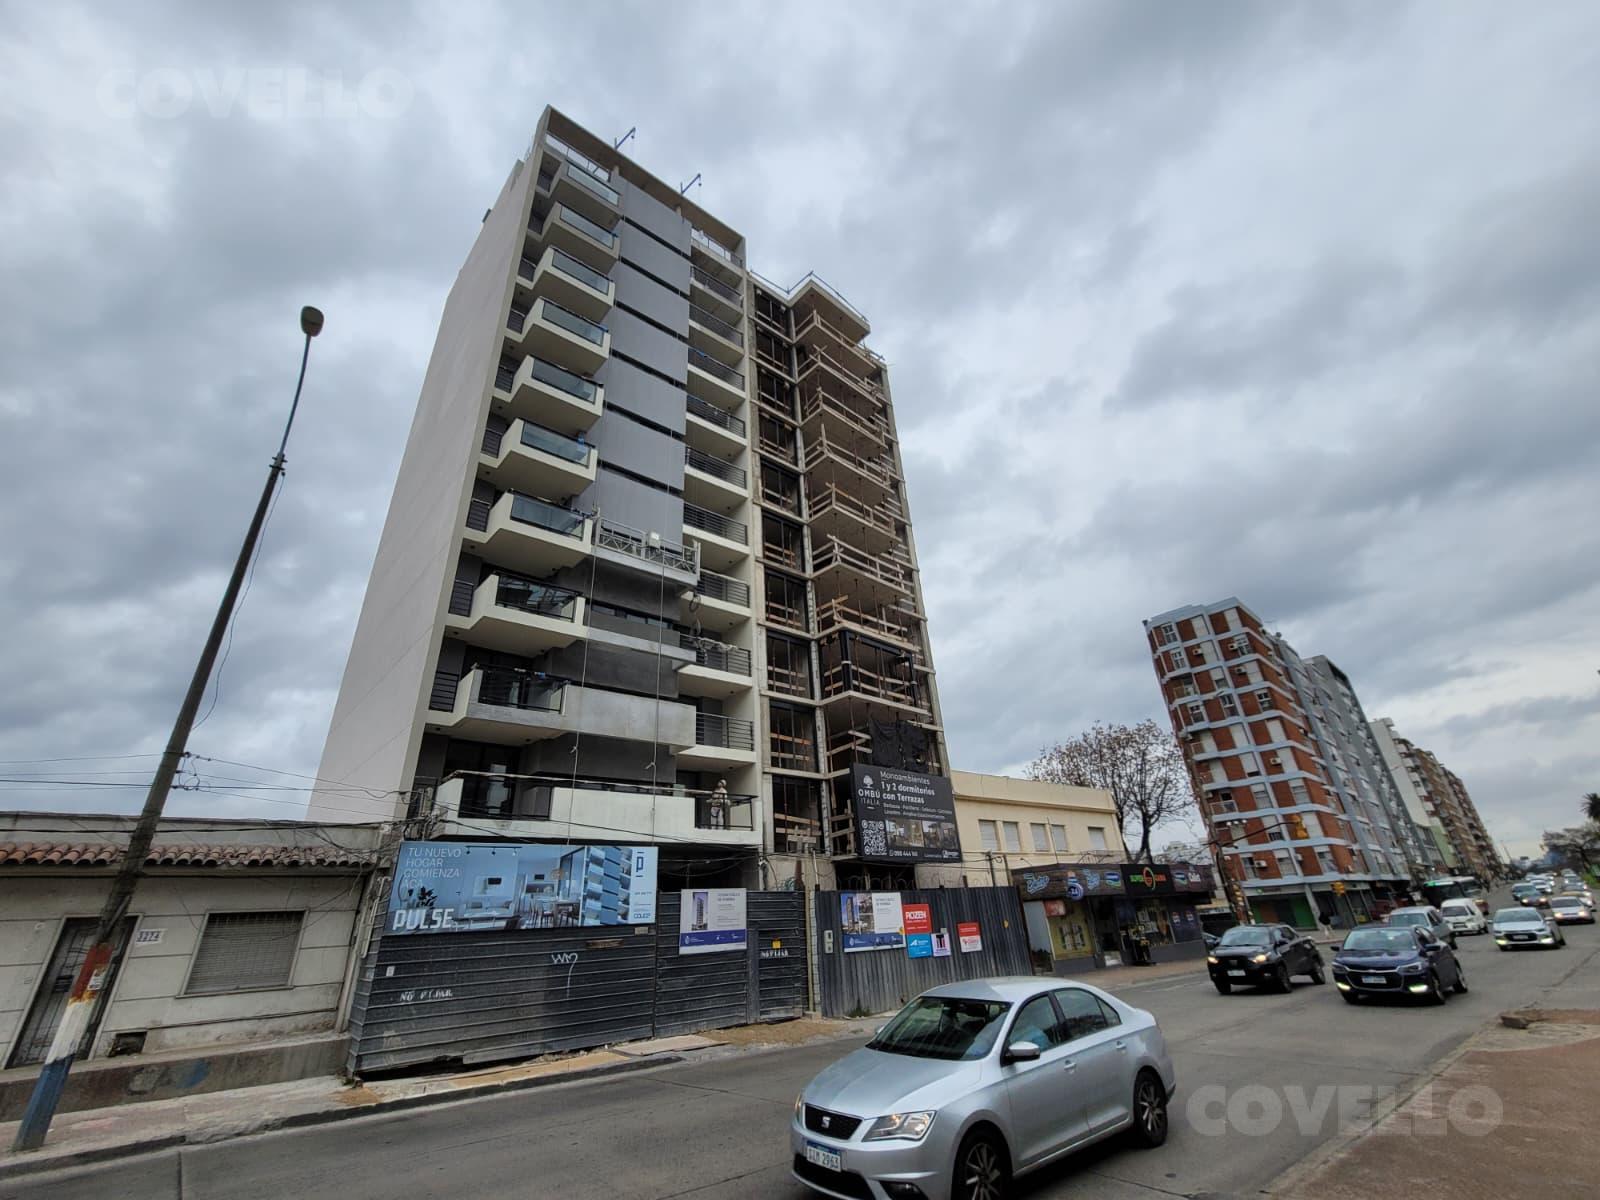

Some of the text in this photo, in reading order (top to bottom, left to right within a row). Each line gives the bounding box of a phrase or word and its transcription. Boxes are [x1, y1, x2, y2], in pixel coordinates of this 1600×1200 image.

[891, 782, 897, 791] 2
[898, 784, 936, 796] dormitorios
[882, 792, 925, 804] con Terrazas
[409, 847, 462, 858] TU NUEVO
[406, 858, 444, 868] HOGAR
[403, 868, 461, 879] COMIENZA
[392, 908, 455, 931] PULSE
